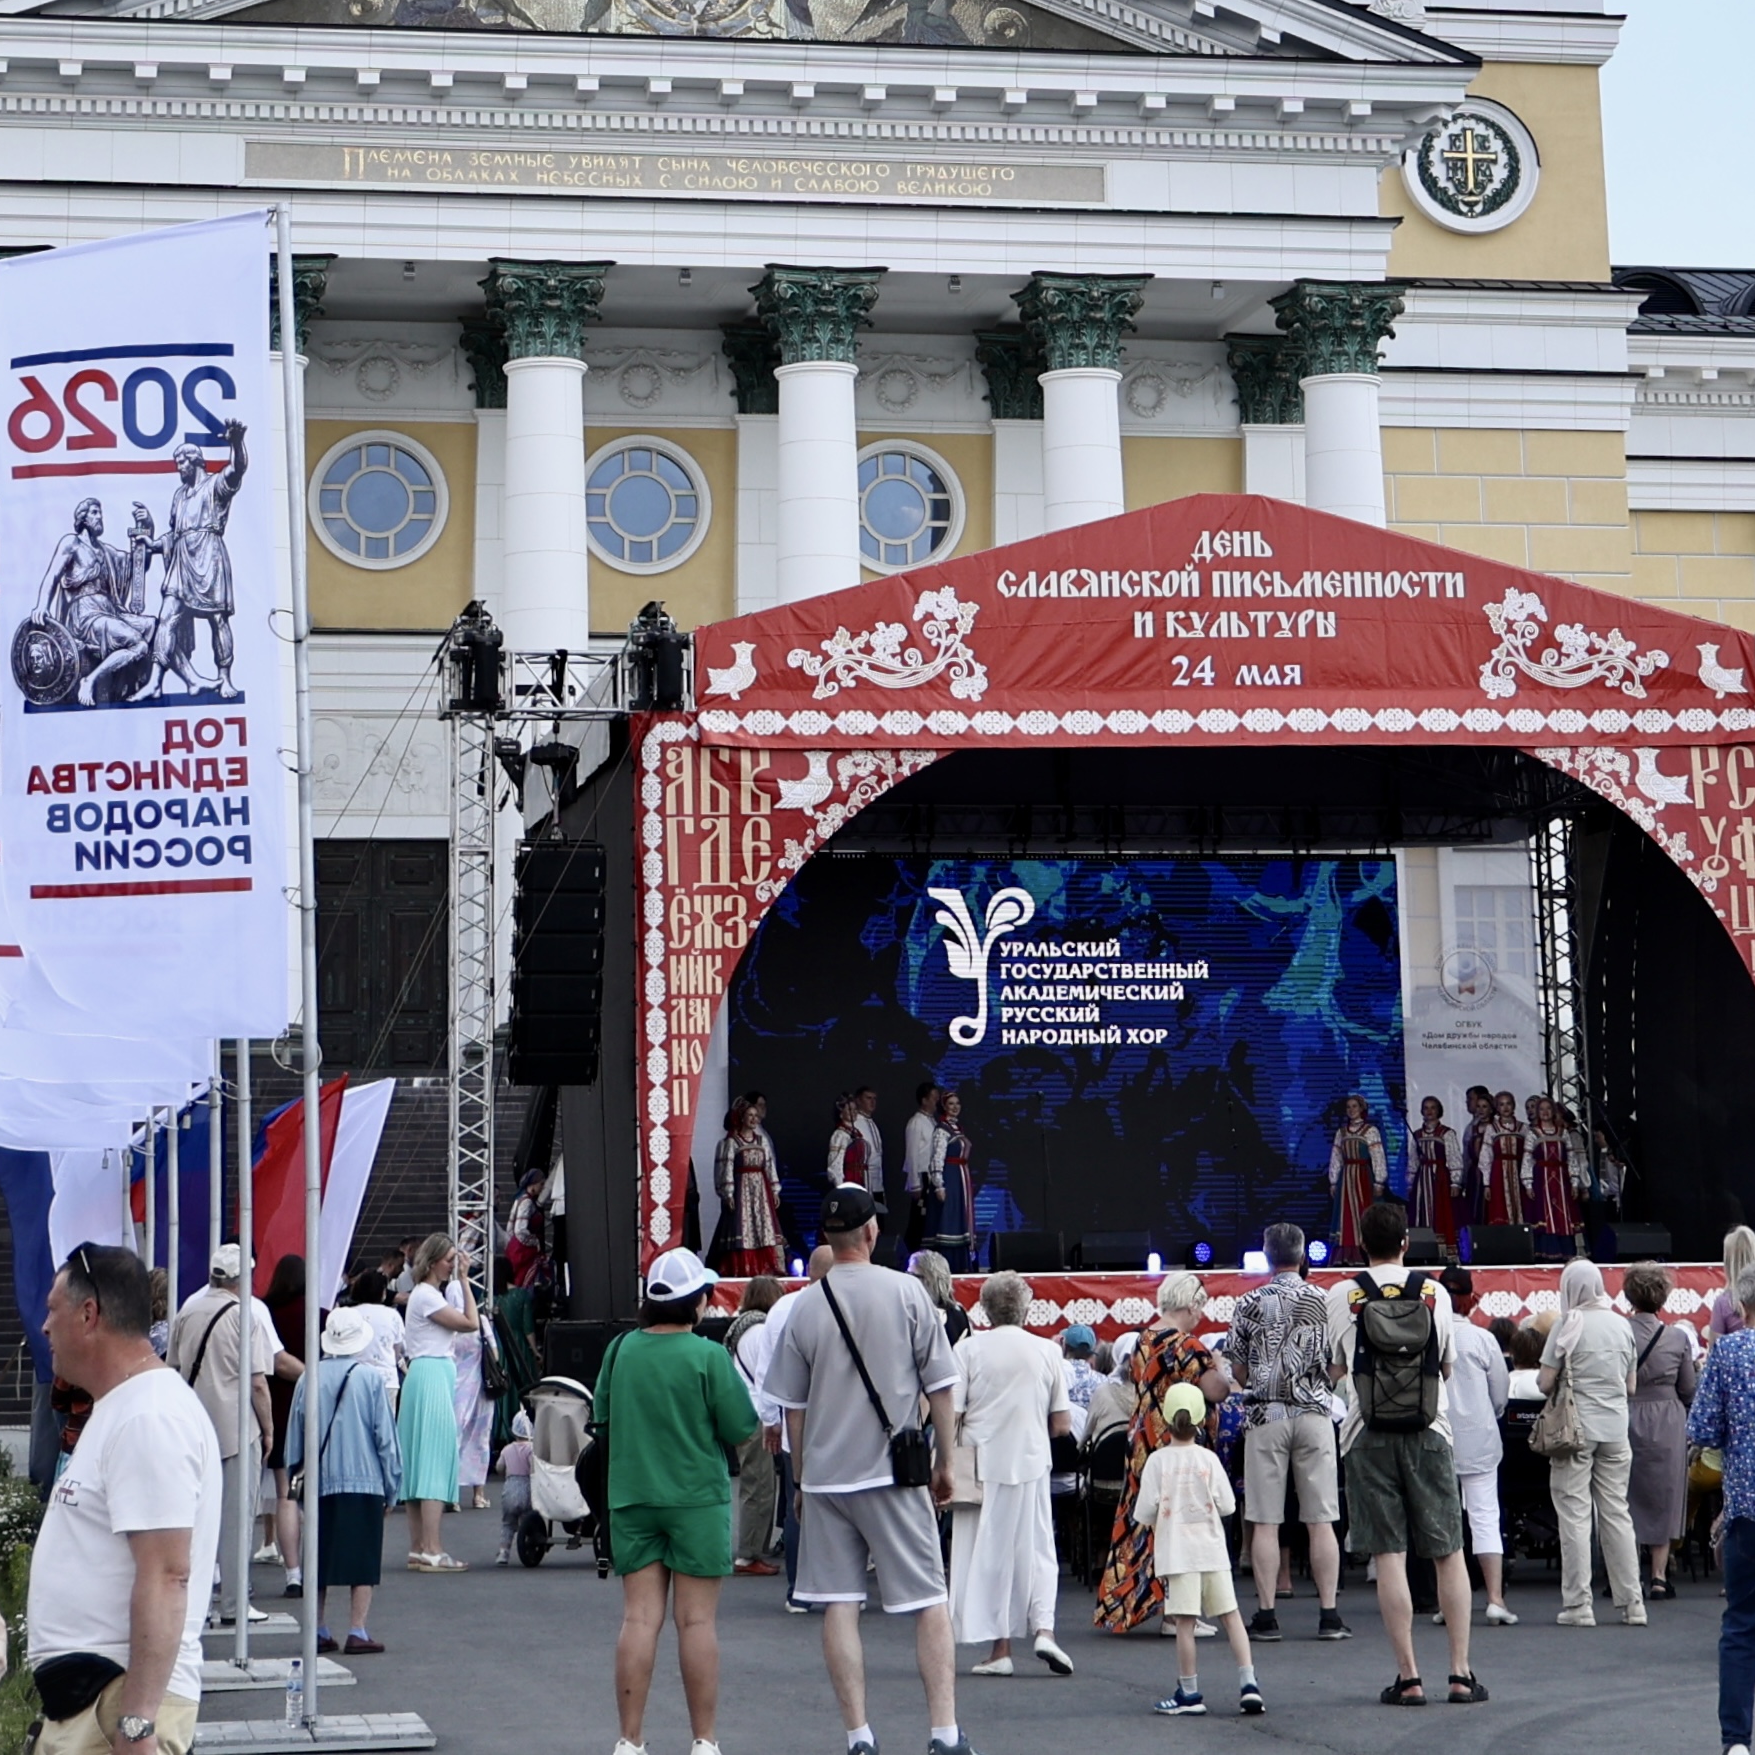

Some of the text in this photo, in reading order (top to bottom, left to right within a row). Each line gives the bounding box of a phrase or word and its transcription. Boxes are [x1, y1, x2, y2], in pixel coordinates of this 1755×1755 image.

[469, 151, 555, 169] ЗЕМНЫЕ
[569, 154, 643, 170] УВИДЯТ
[657, 157, 711, 172] СЫНА
[726, 159, 890, 178] ЧЕЛОВЕЧЕСКОГО
[387, 167, 411, 179] НА
[426, 168, 520, 183] ОБЛАКАХ
[536, 171, 644, 188] НЕБЕСНЫХ
[897, 180, 992, 197] ВЕЛИКОЮ
[1191, 530, 1273, 564] ДЕНЬ
[997, 563, 1465, 599] СЛАВЯНСКОЙ ПИСЬМЕННОСТИ
[1134, 609, 1337, 638] И КУЛЬТУРЫ
[1171, 655, 1216, 687] 24
[999, 938, 1121, 958] УРАЛЬСКИЙ
[1000, 959, 1209, 981] ГОСУДАРСТВЕННЫЙ
[1000, 981, 1184, 1003] АКАДЕМИЧЕСКИЙ
[1001, 1003, 1100, 1023] РУССКИЙ
[1001, 1025, 1168, 1046] НАРОДНЫЙ ХОР
